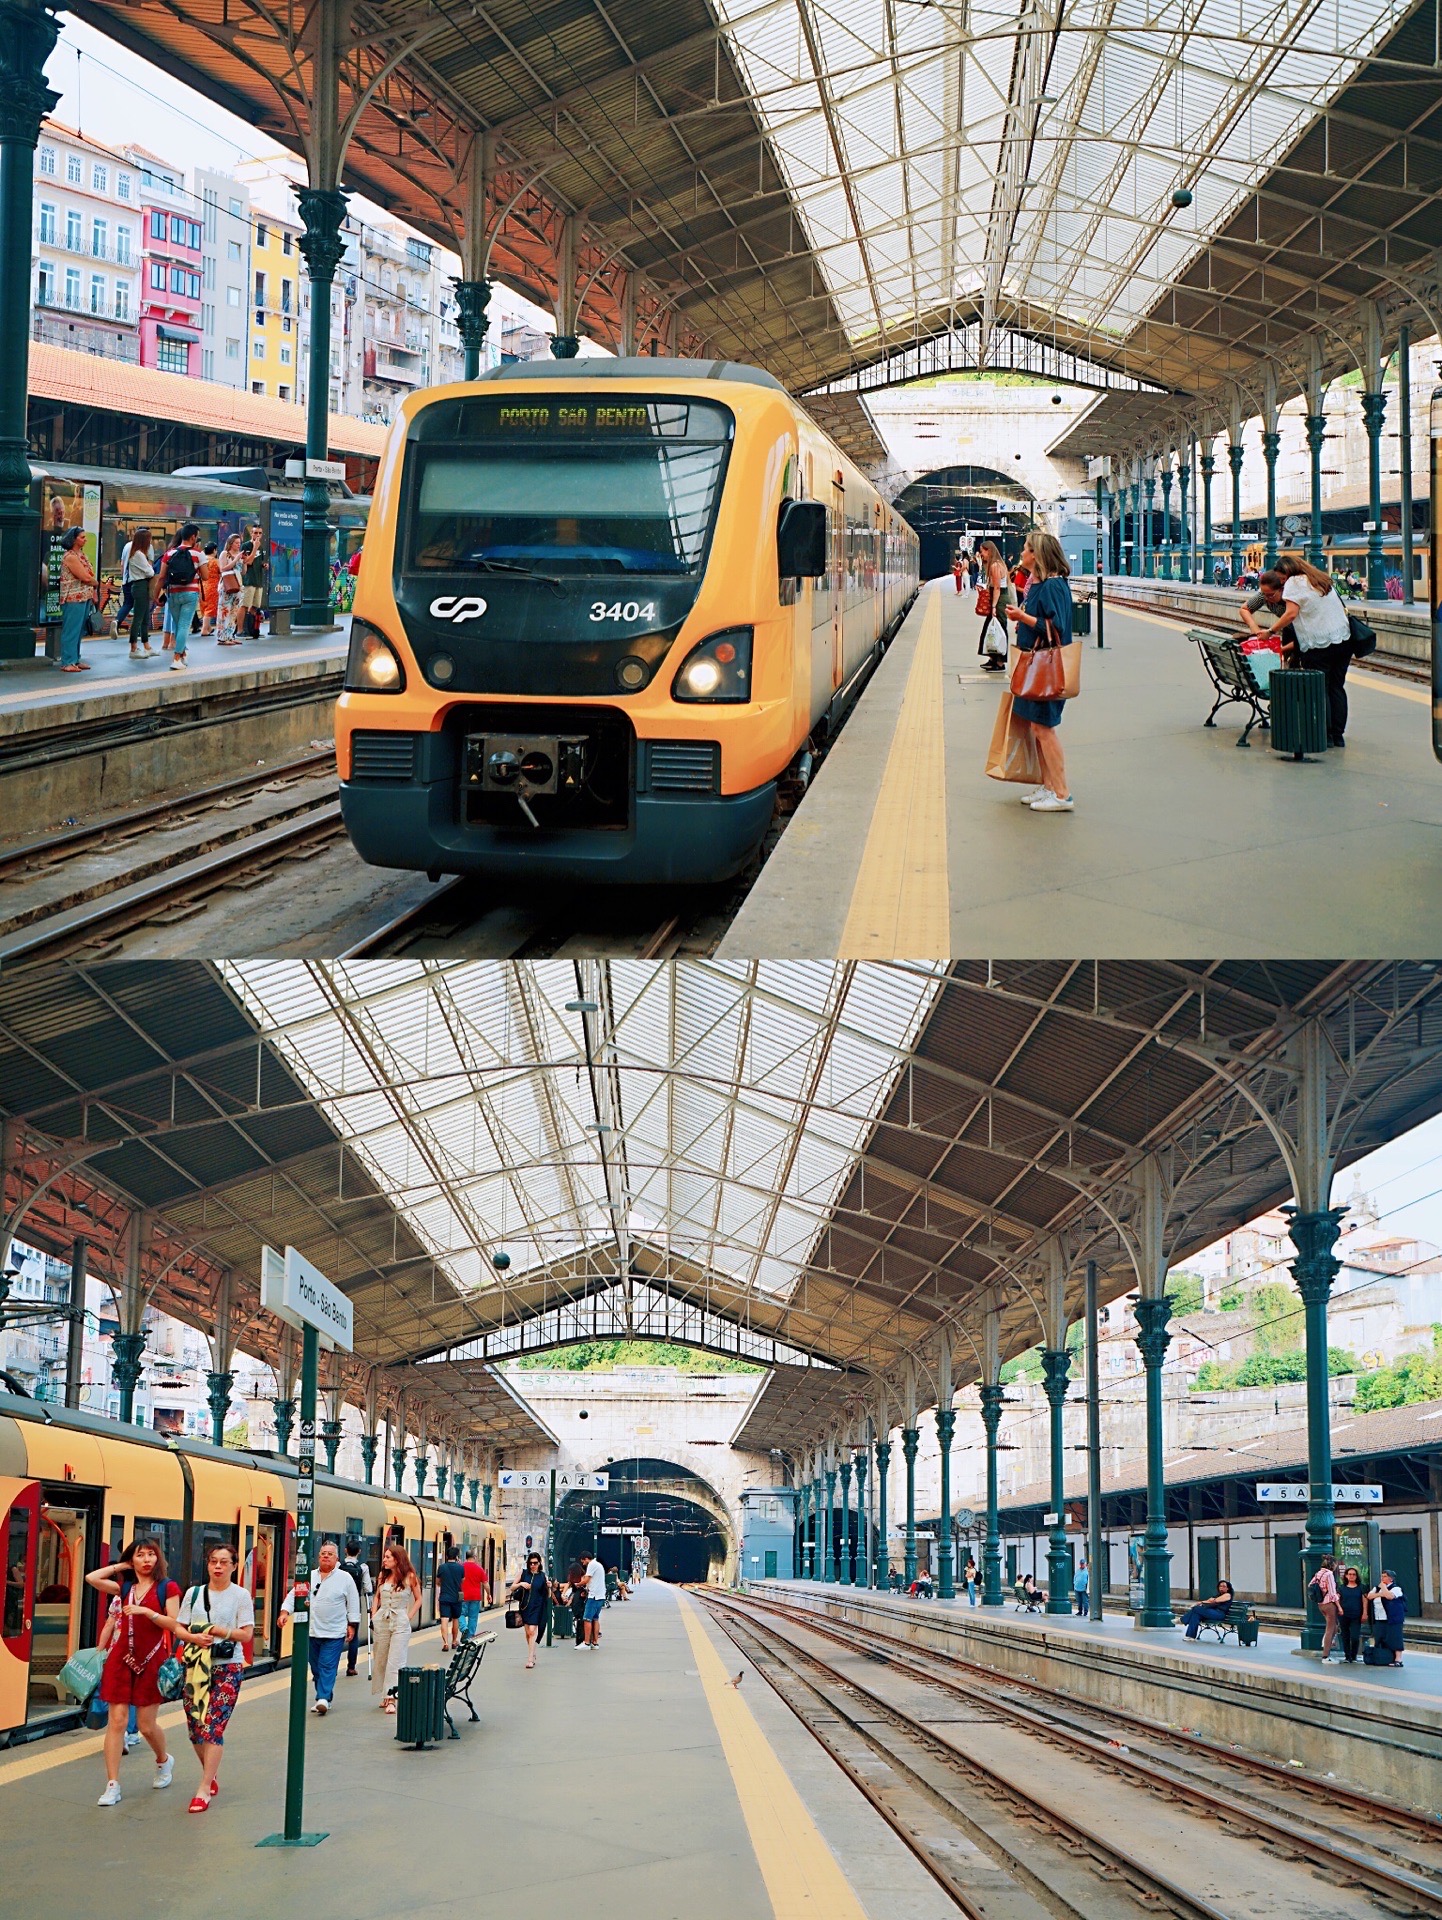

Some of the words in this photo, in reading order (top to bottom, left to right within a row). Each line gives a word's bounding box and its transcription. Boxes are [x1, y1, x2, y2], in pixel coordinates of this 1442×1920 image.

[500, 408, 549, 426] PORTO
[596, 408, 647, 426] BENTO
[589, 601, 656, 622] 3404
[299, 1274, 316, 1306] Porto
[321, 1292, 331, 1318] São
[332, 1302, 347, 1330] Bento
[521, 1476, 528, 1486] 3
[538, 1475, 546, 1484] A
[560, 1475, 568, 1485] A
[578, 1477, 585, 1486] 4
[1280, 1489, 1287, 1499] 5
[1297, 1488, 1305, 1497] A
[1336, 1488, 1344, 1498] A
[1354, 1490, 1360, 1499] 6
